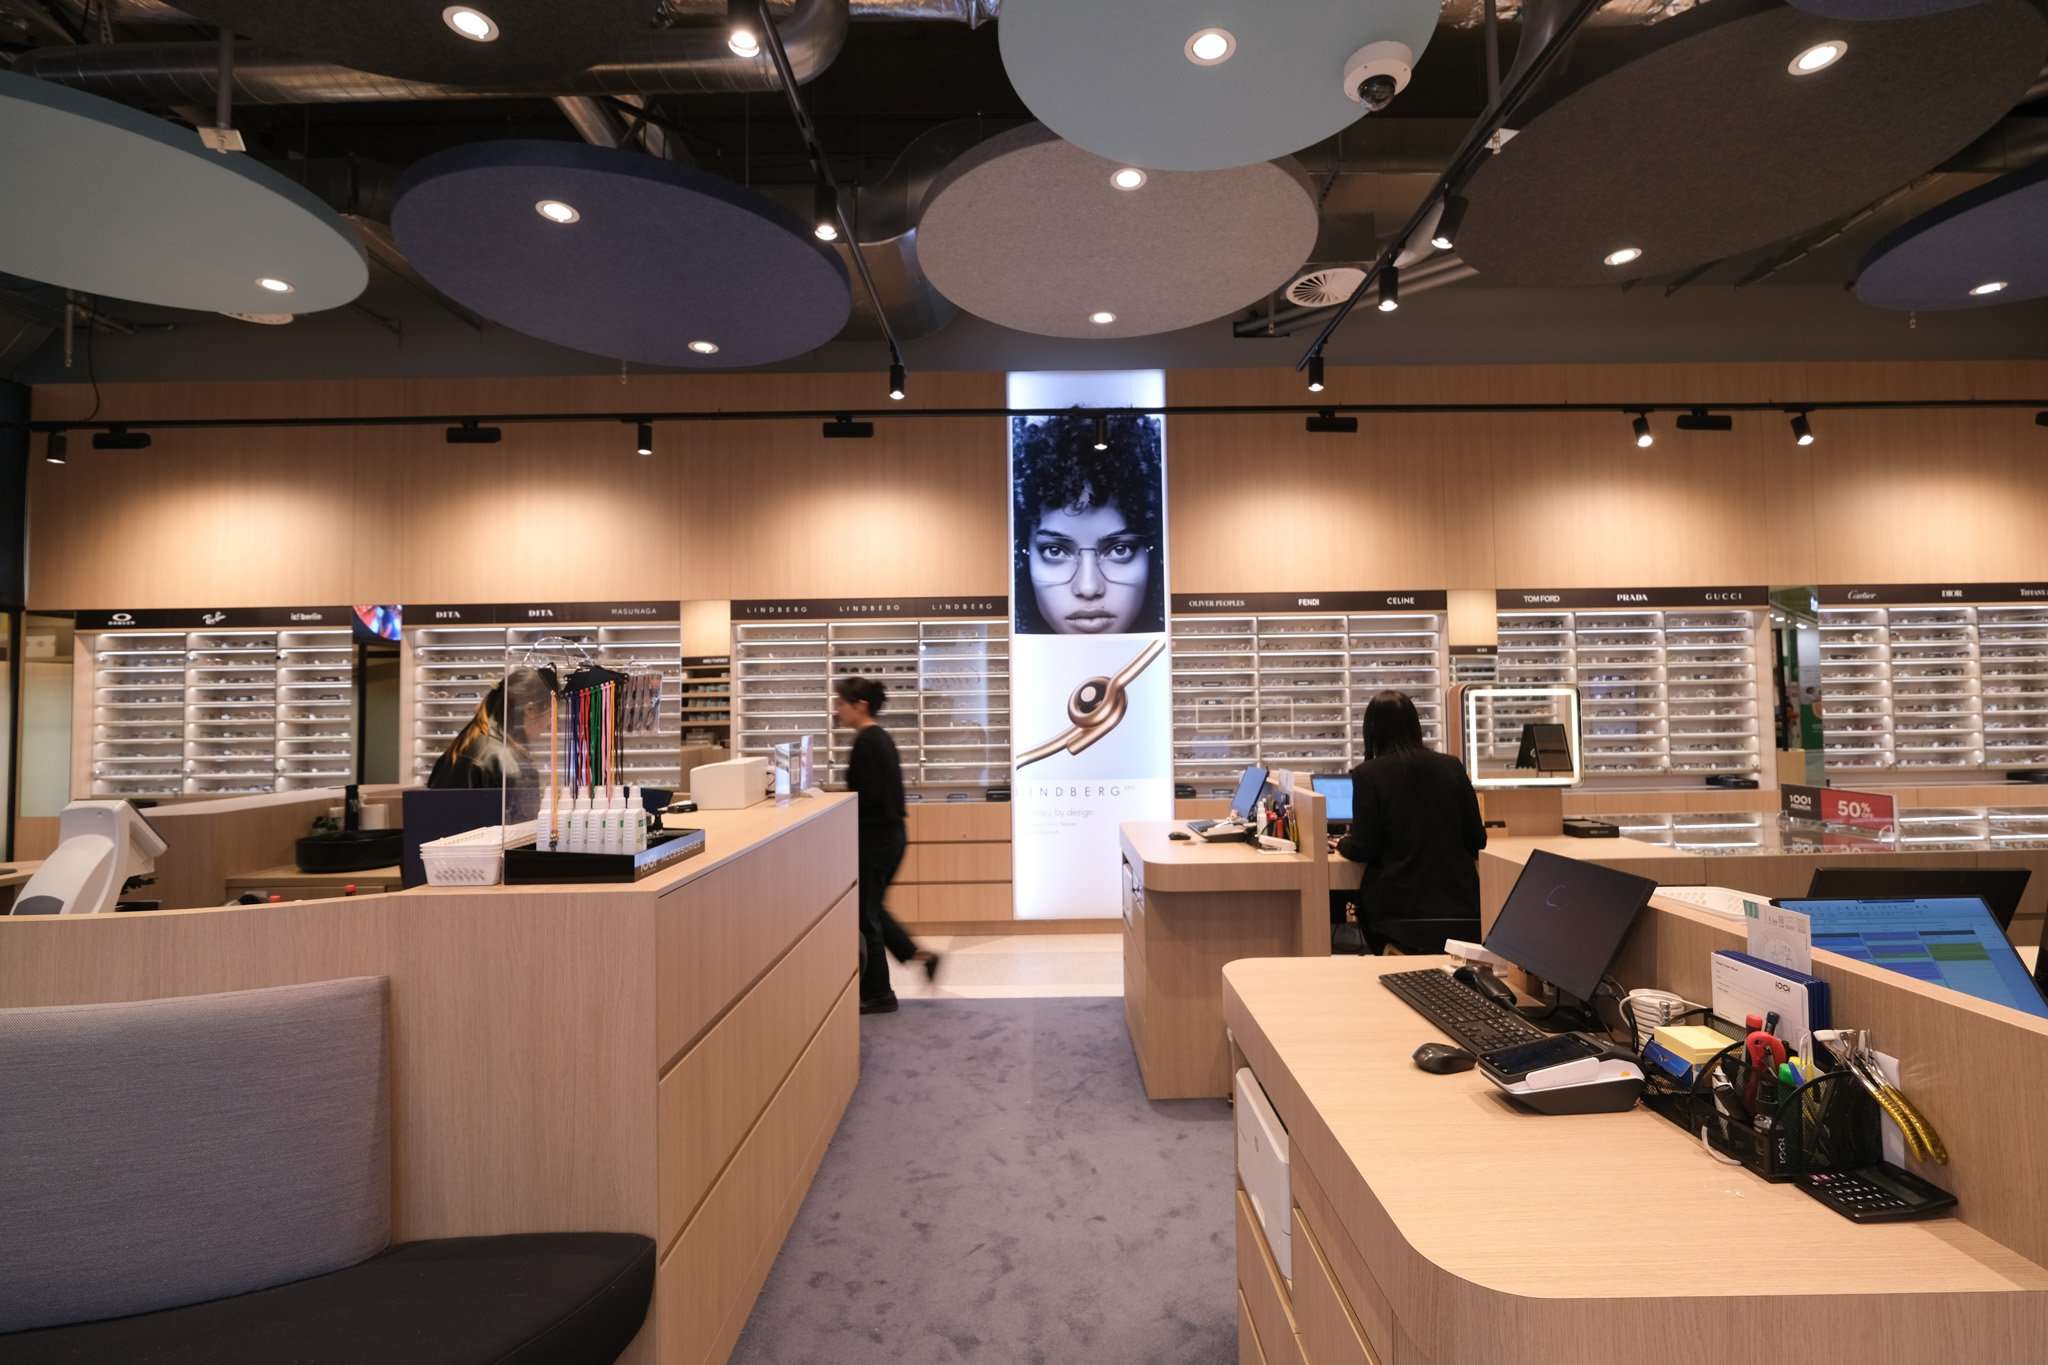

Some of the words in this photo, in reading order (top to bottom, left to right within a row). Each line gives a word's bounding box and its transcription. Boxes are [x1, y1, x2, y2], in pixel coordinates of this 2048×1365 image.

[1386, 596, 1415, 605] CELINE
[1523, 594, 1540, 603] TOM
[1540, 594, 1561, 603] FORD
[1616, 593, 1649, 602] PRADA
[1705, 592, 1742, 601] GUCCI
[931, 603, 993, 611] LINDBERG
[1188, 599, 1215, 608] OLIVER
[1215, 598, 1245, 607] PEOPLES
[1297, 598, 1320, 607] FENDI
[611, 607, 657, 615] MASUNAGA
[746, 606, 808, 614] LINDBERG
[839, 604, 900, 612] LINDBERG
[435, 610, 461, 619] DITA
[528, 609, 554, 617] DITA
[1788, 794, 1812, 804] 1001
[1837, 799, 1872, 818] 50%
